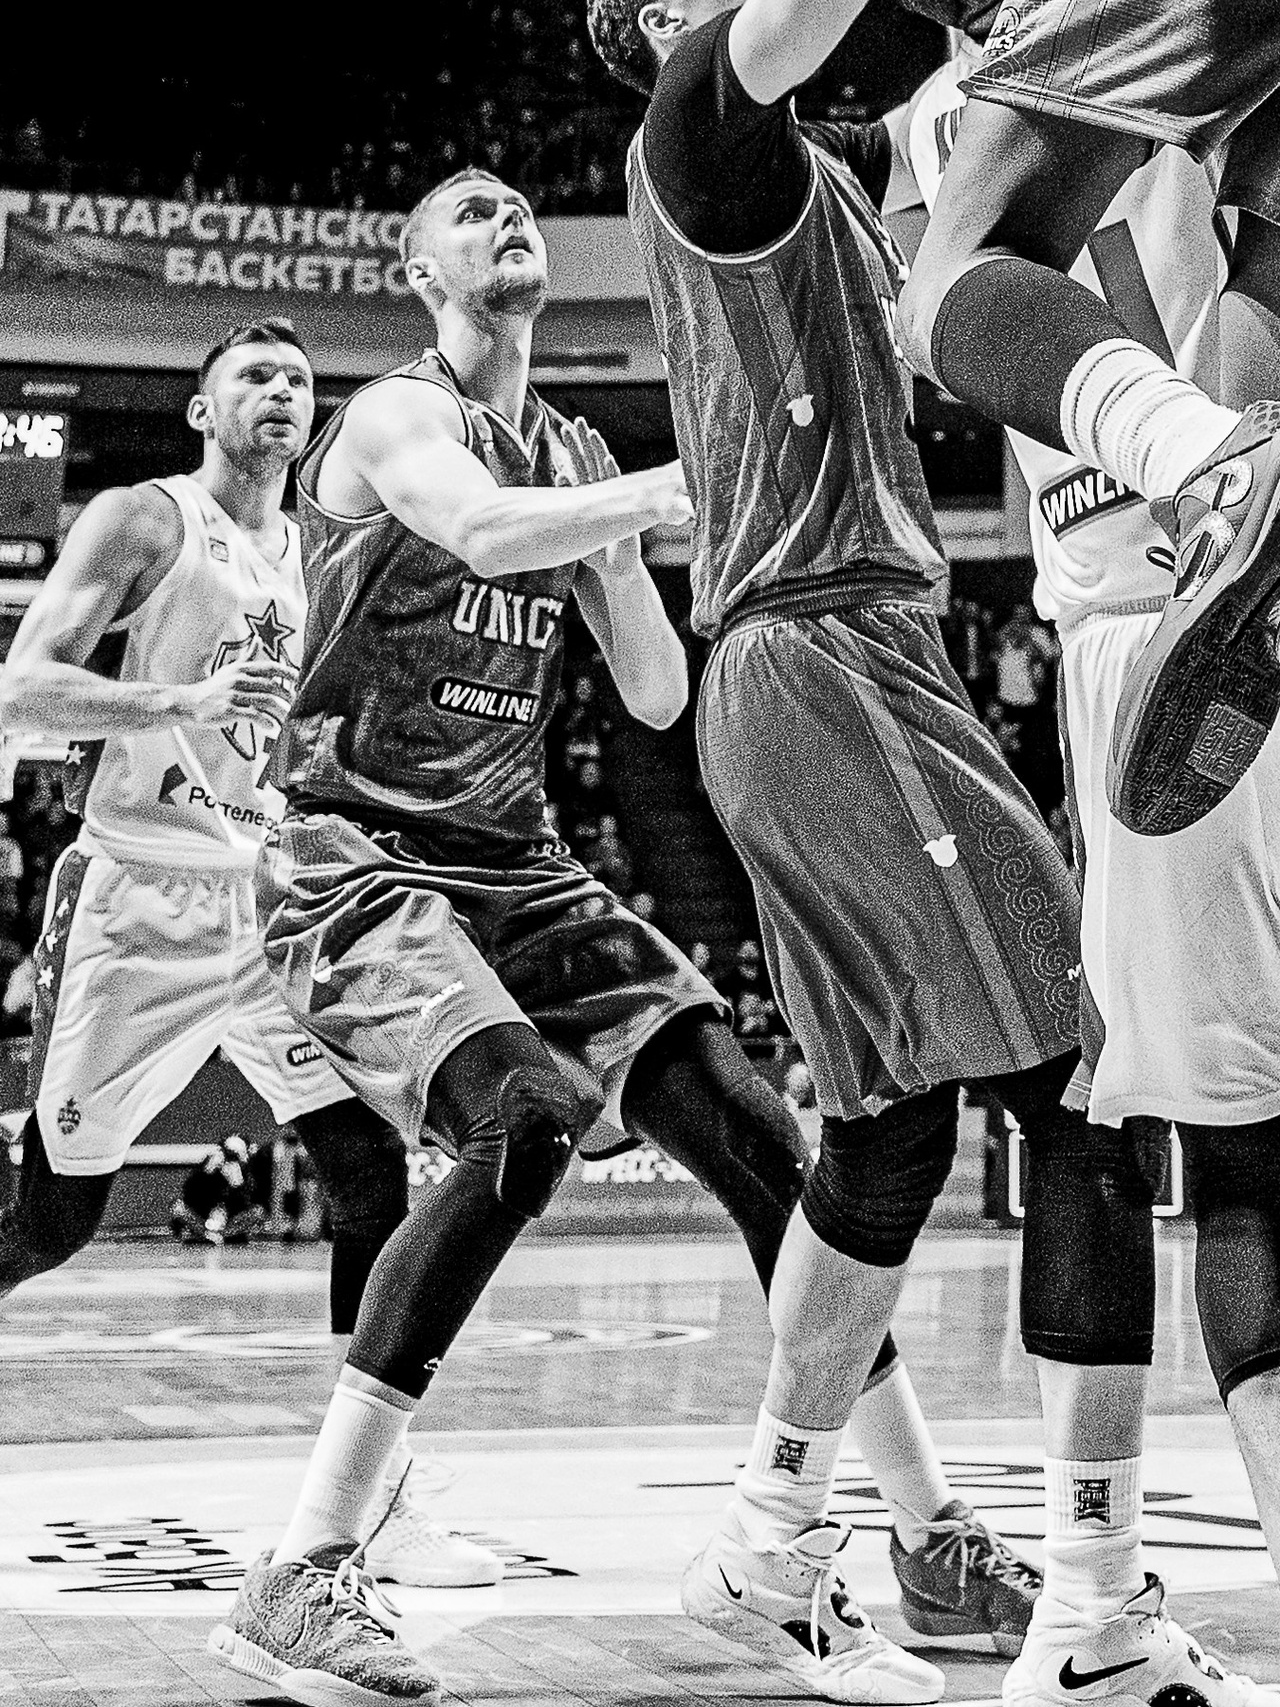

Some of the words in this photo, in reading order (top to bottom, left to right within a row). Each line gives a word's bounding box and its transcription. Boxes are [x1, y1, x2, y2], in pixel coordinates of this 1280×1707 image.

[39, 194, 408, 248] ТАТАРСТАНСКО
[164, 248, 411, 294] БАСКЕТБО
[452, 581, 563, 650] UNIC
